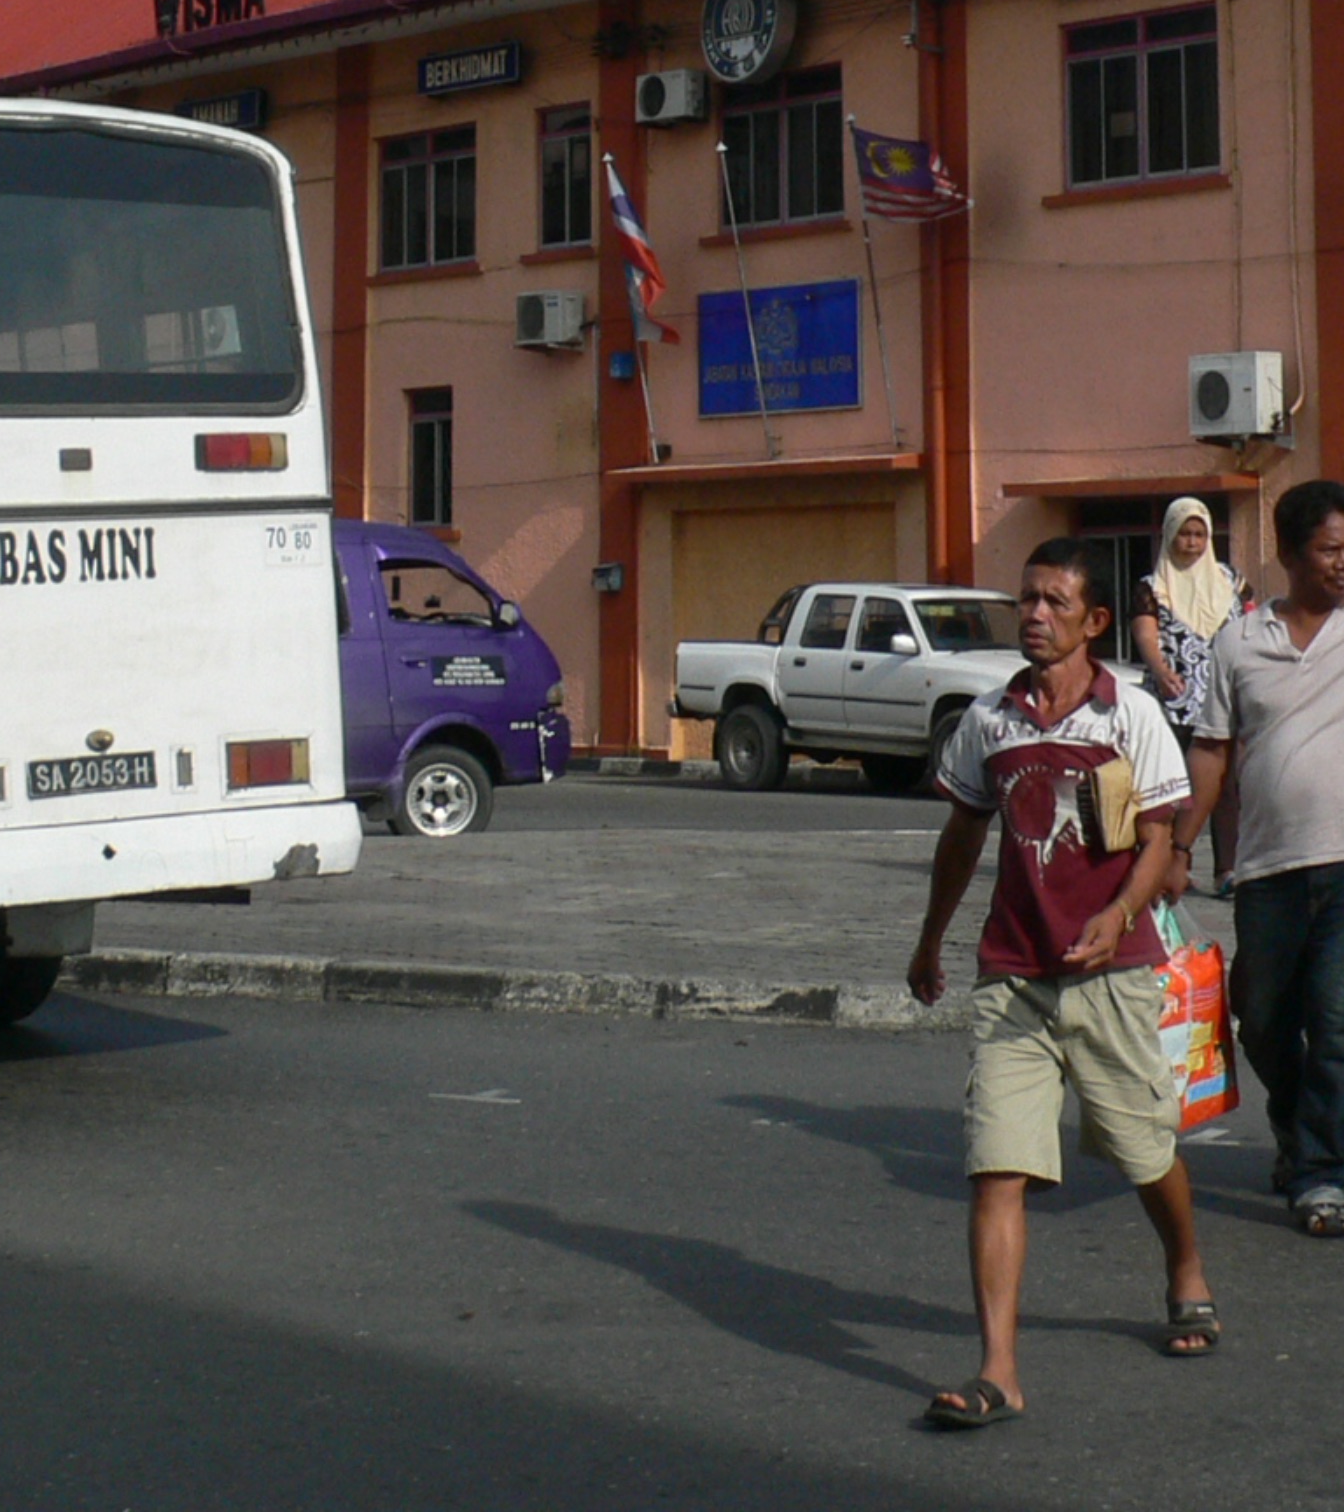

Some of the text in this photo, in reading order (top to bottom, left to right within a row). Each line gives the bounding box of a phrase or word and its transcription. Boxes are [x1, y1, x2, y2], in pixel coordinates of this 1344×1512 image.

[425, 48, 508, 89] BERKHIDMAT
[78, 526, 157, 582] MINI
[265, 526, 287, 549] 70
[35, 756, 150, 792] SA 2053 H
